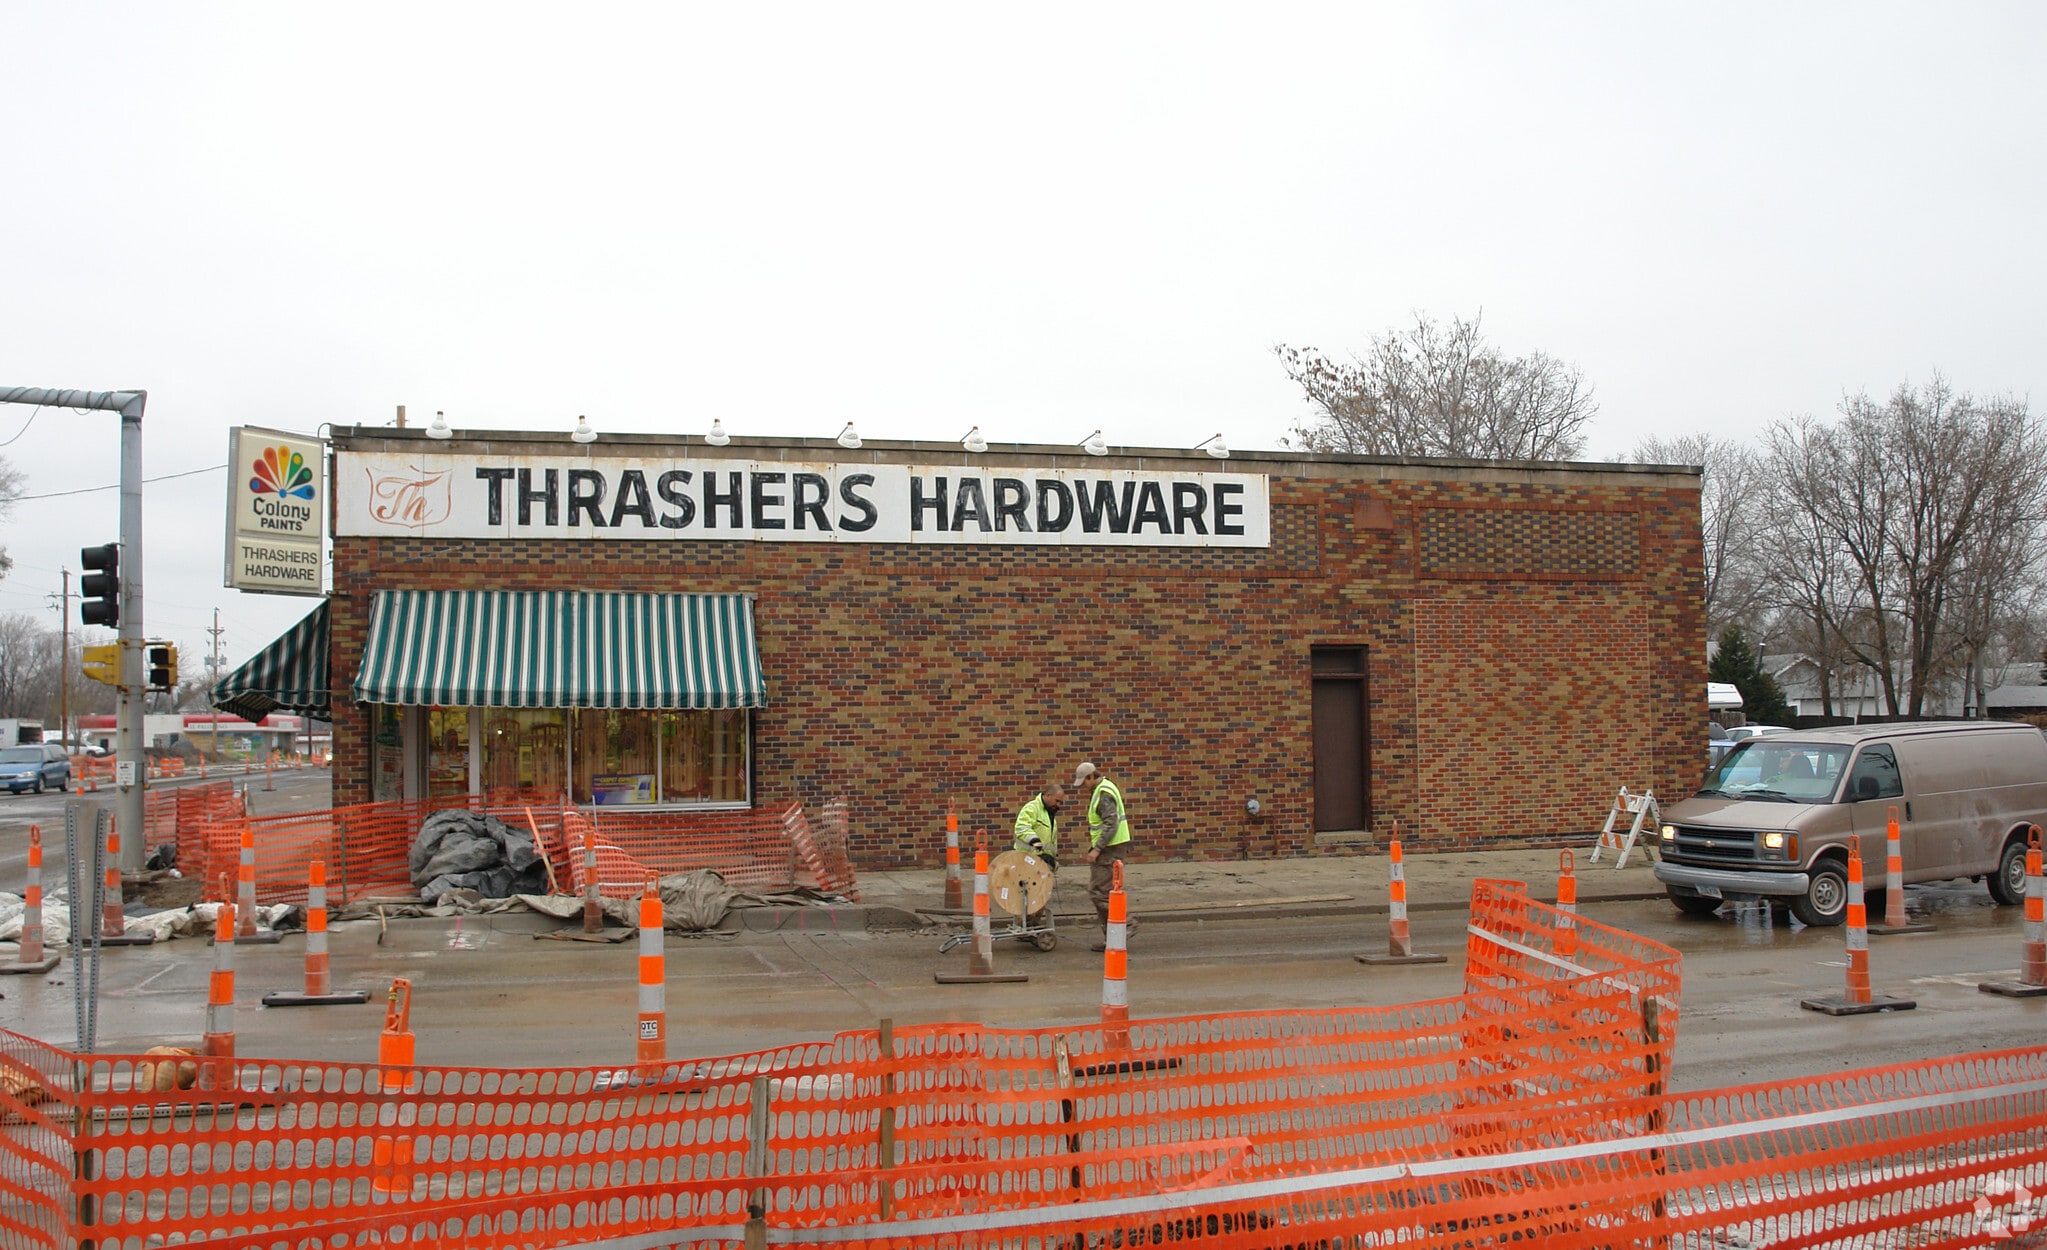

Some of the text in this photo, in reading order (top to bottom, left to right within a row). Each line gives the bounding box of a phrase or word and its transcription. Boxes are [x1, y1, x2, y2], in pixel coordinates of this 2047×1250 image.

[253, 496, 310, 521] Colony
[476, 467, 1245, 536] THRASHERS HARDWARE
[260, 517, 303, 531] PAINTS
[242, 546, 318, 564] THRASHERS
[245, 564, 315, 581] HARDWARE
